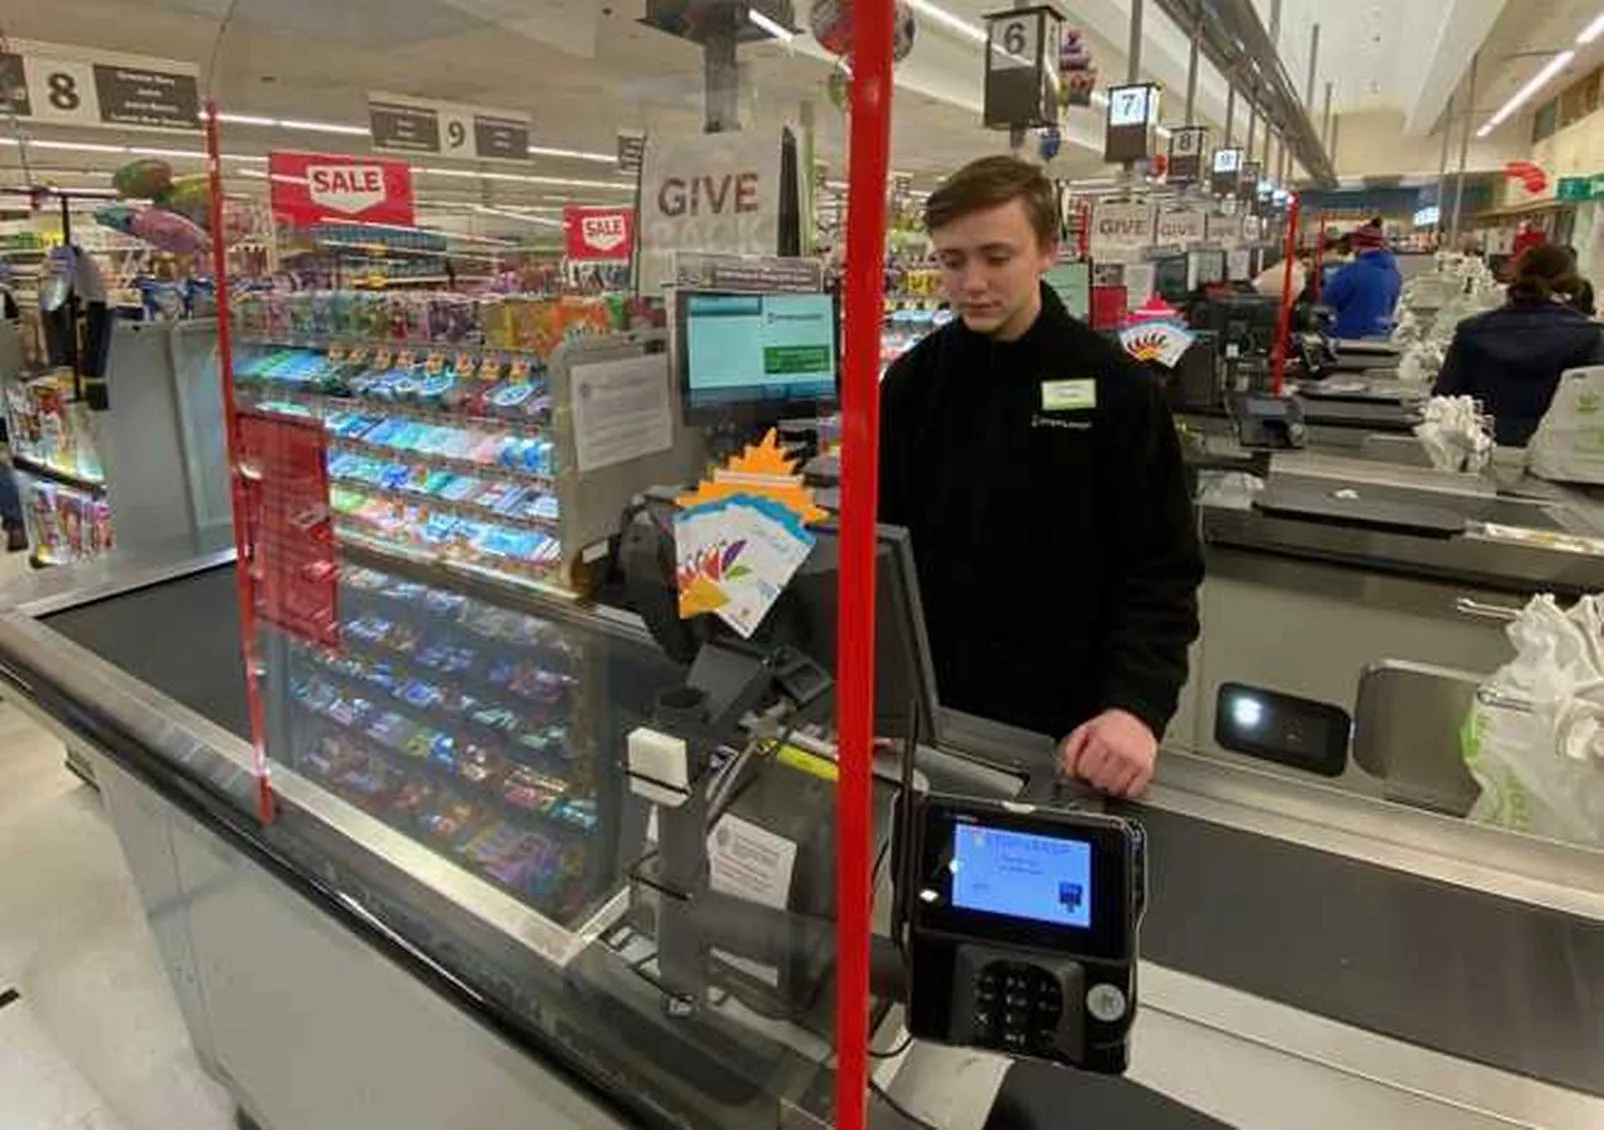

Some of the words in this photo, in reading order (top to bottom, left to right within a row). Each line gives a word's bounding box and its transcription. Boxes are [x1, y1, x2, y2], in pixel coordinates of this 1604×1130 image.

[1003, 23, 1027, 54] 6
[47, 73, 80, 110] 8
[1120, 94, 1136, 116] 7
[448, 120, 466, 148] 9
[313, 170, 381, 194] SALE
[657, 173, 760, 217] GIVE
[586, 218, 623, 237] SALE
[1100, 217, 1147, 235] GIVE
